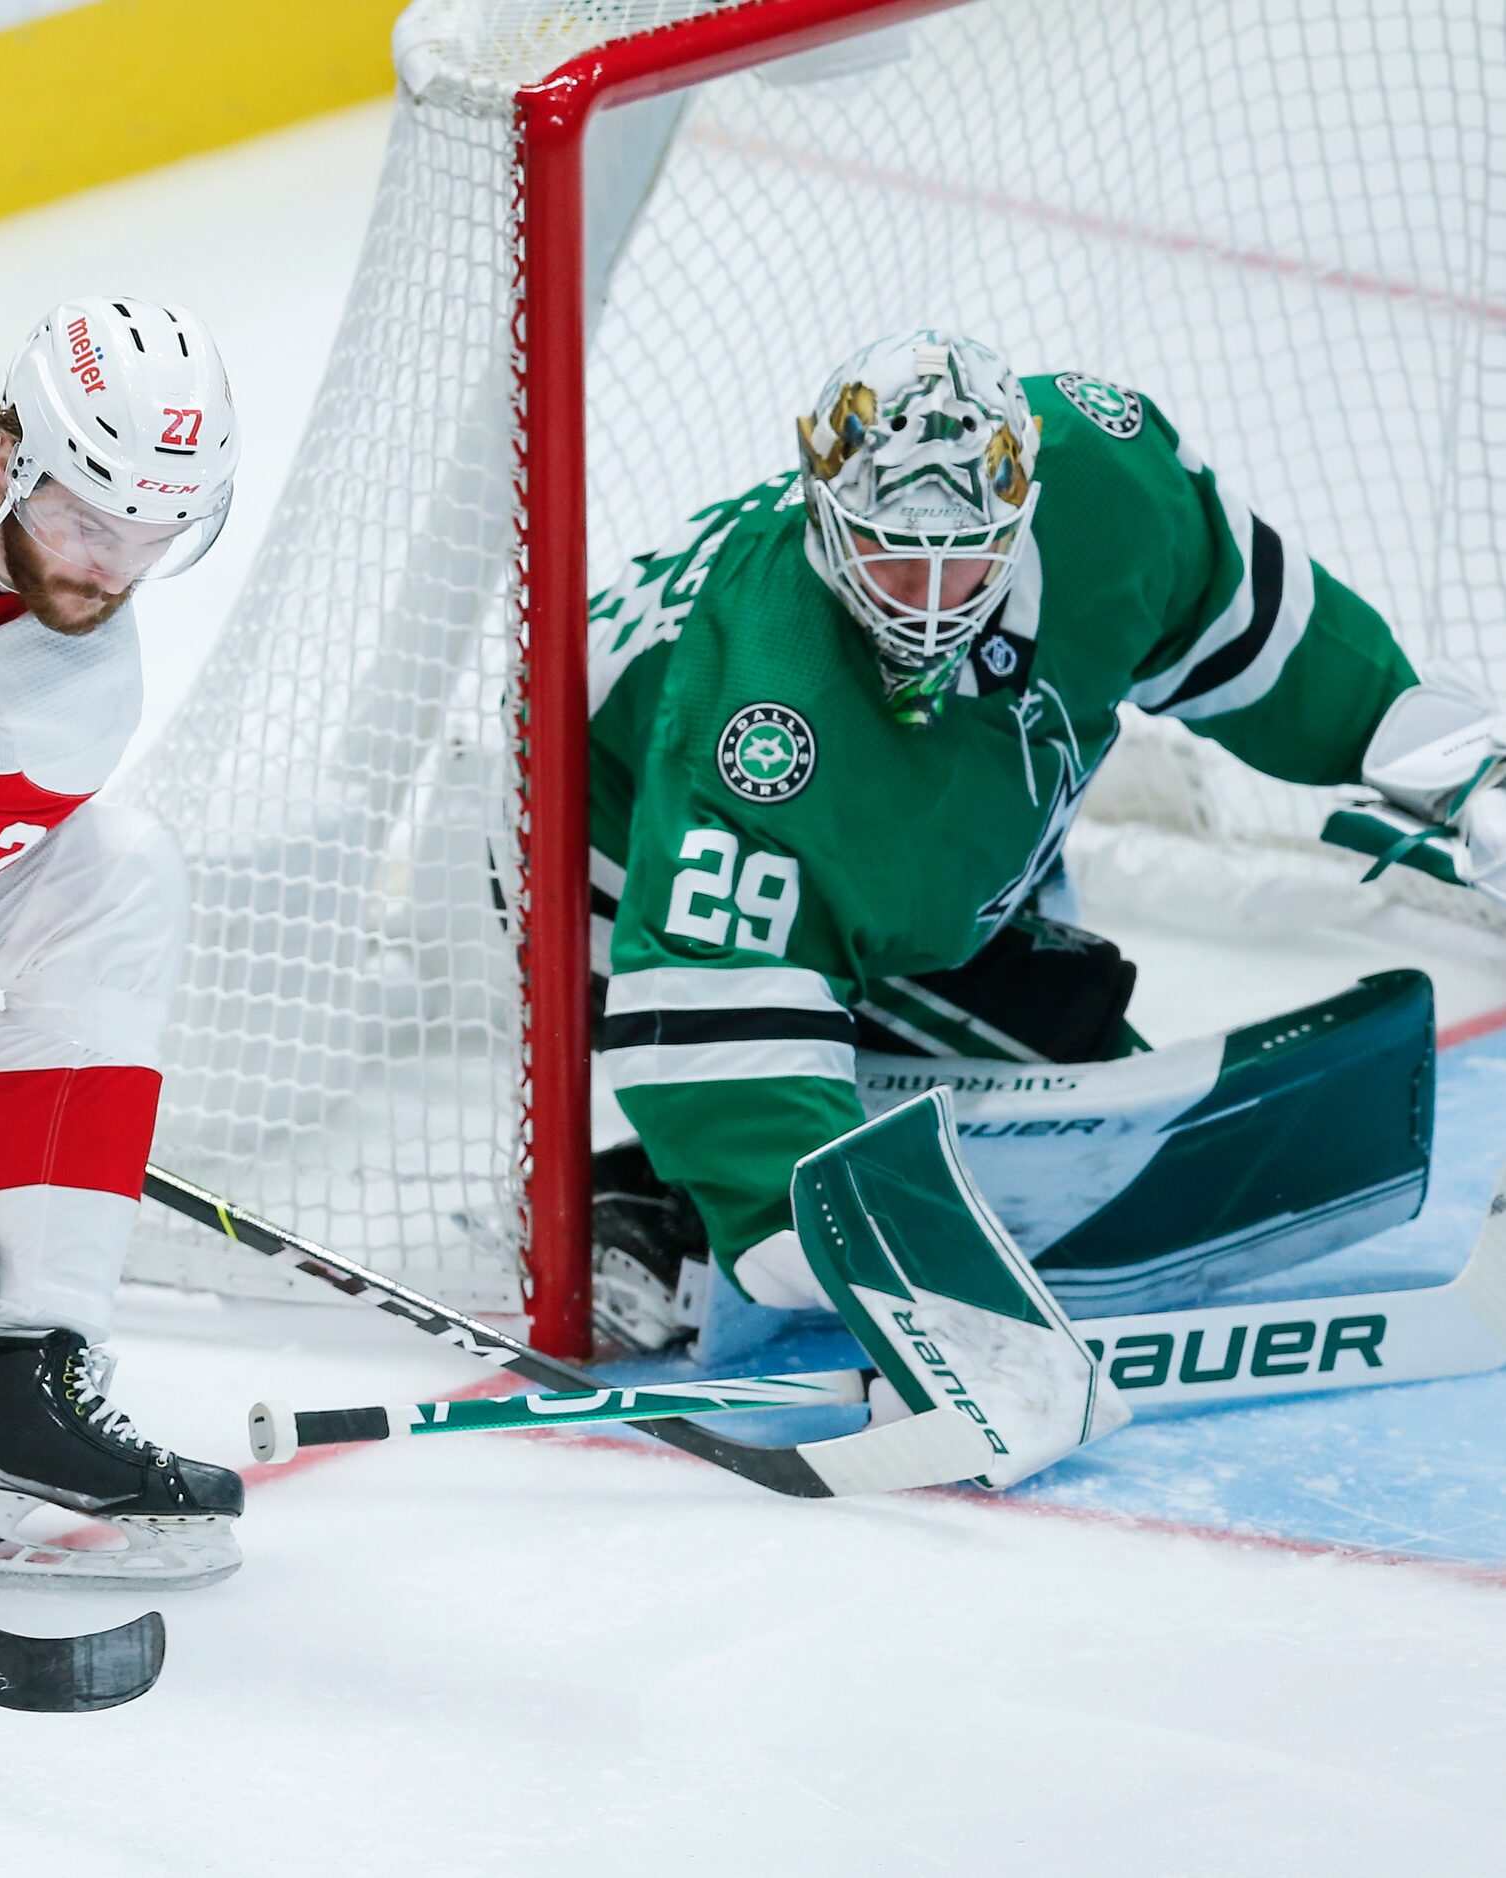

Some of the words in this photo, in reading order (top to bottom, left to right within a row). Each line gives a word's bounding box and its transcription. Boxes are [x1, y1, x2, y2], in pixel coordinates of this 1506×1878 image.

[66, 317, 107, 395] meijer
[161, 408, 202, 446] 27
[136, 479, 201, 494] CCM
[735, 709, 811, 766] DALLAS
[722, 750, 791, 797] STARS
[665, 828, 801, 959] 29
